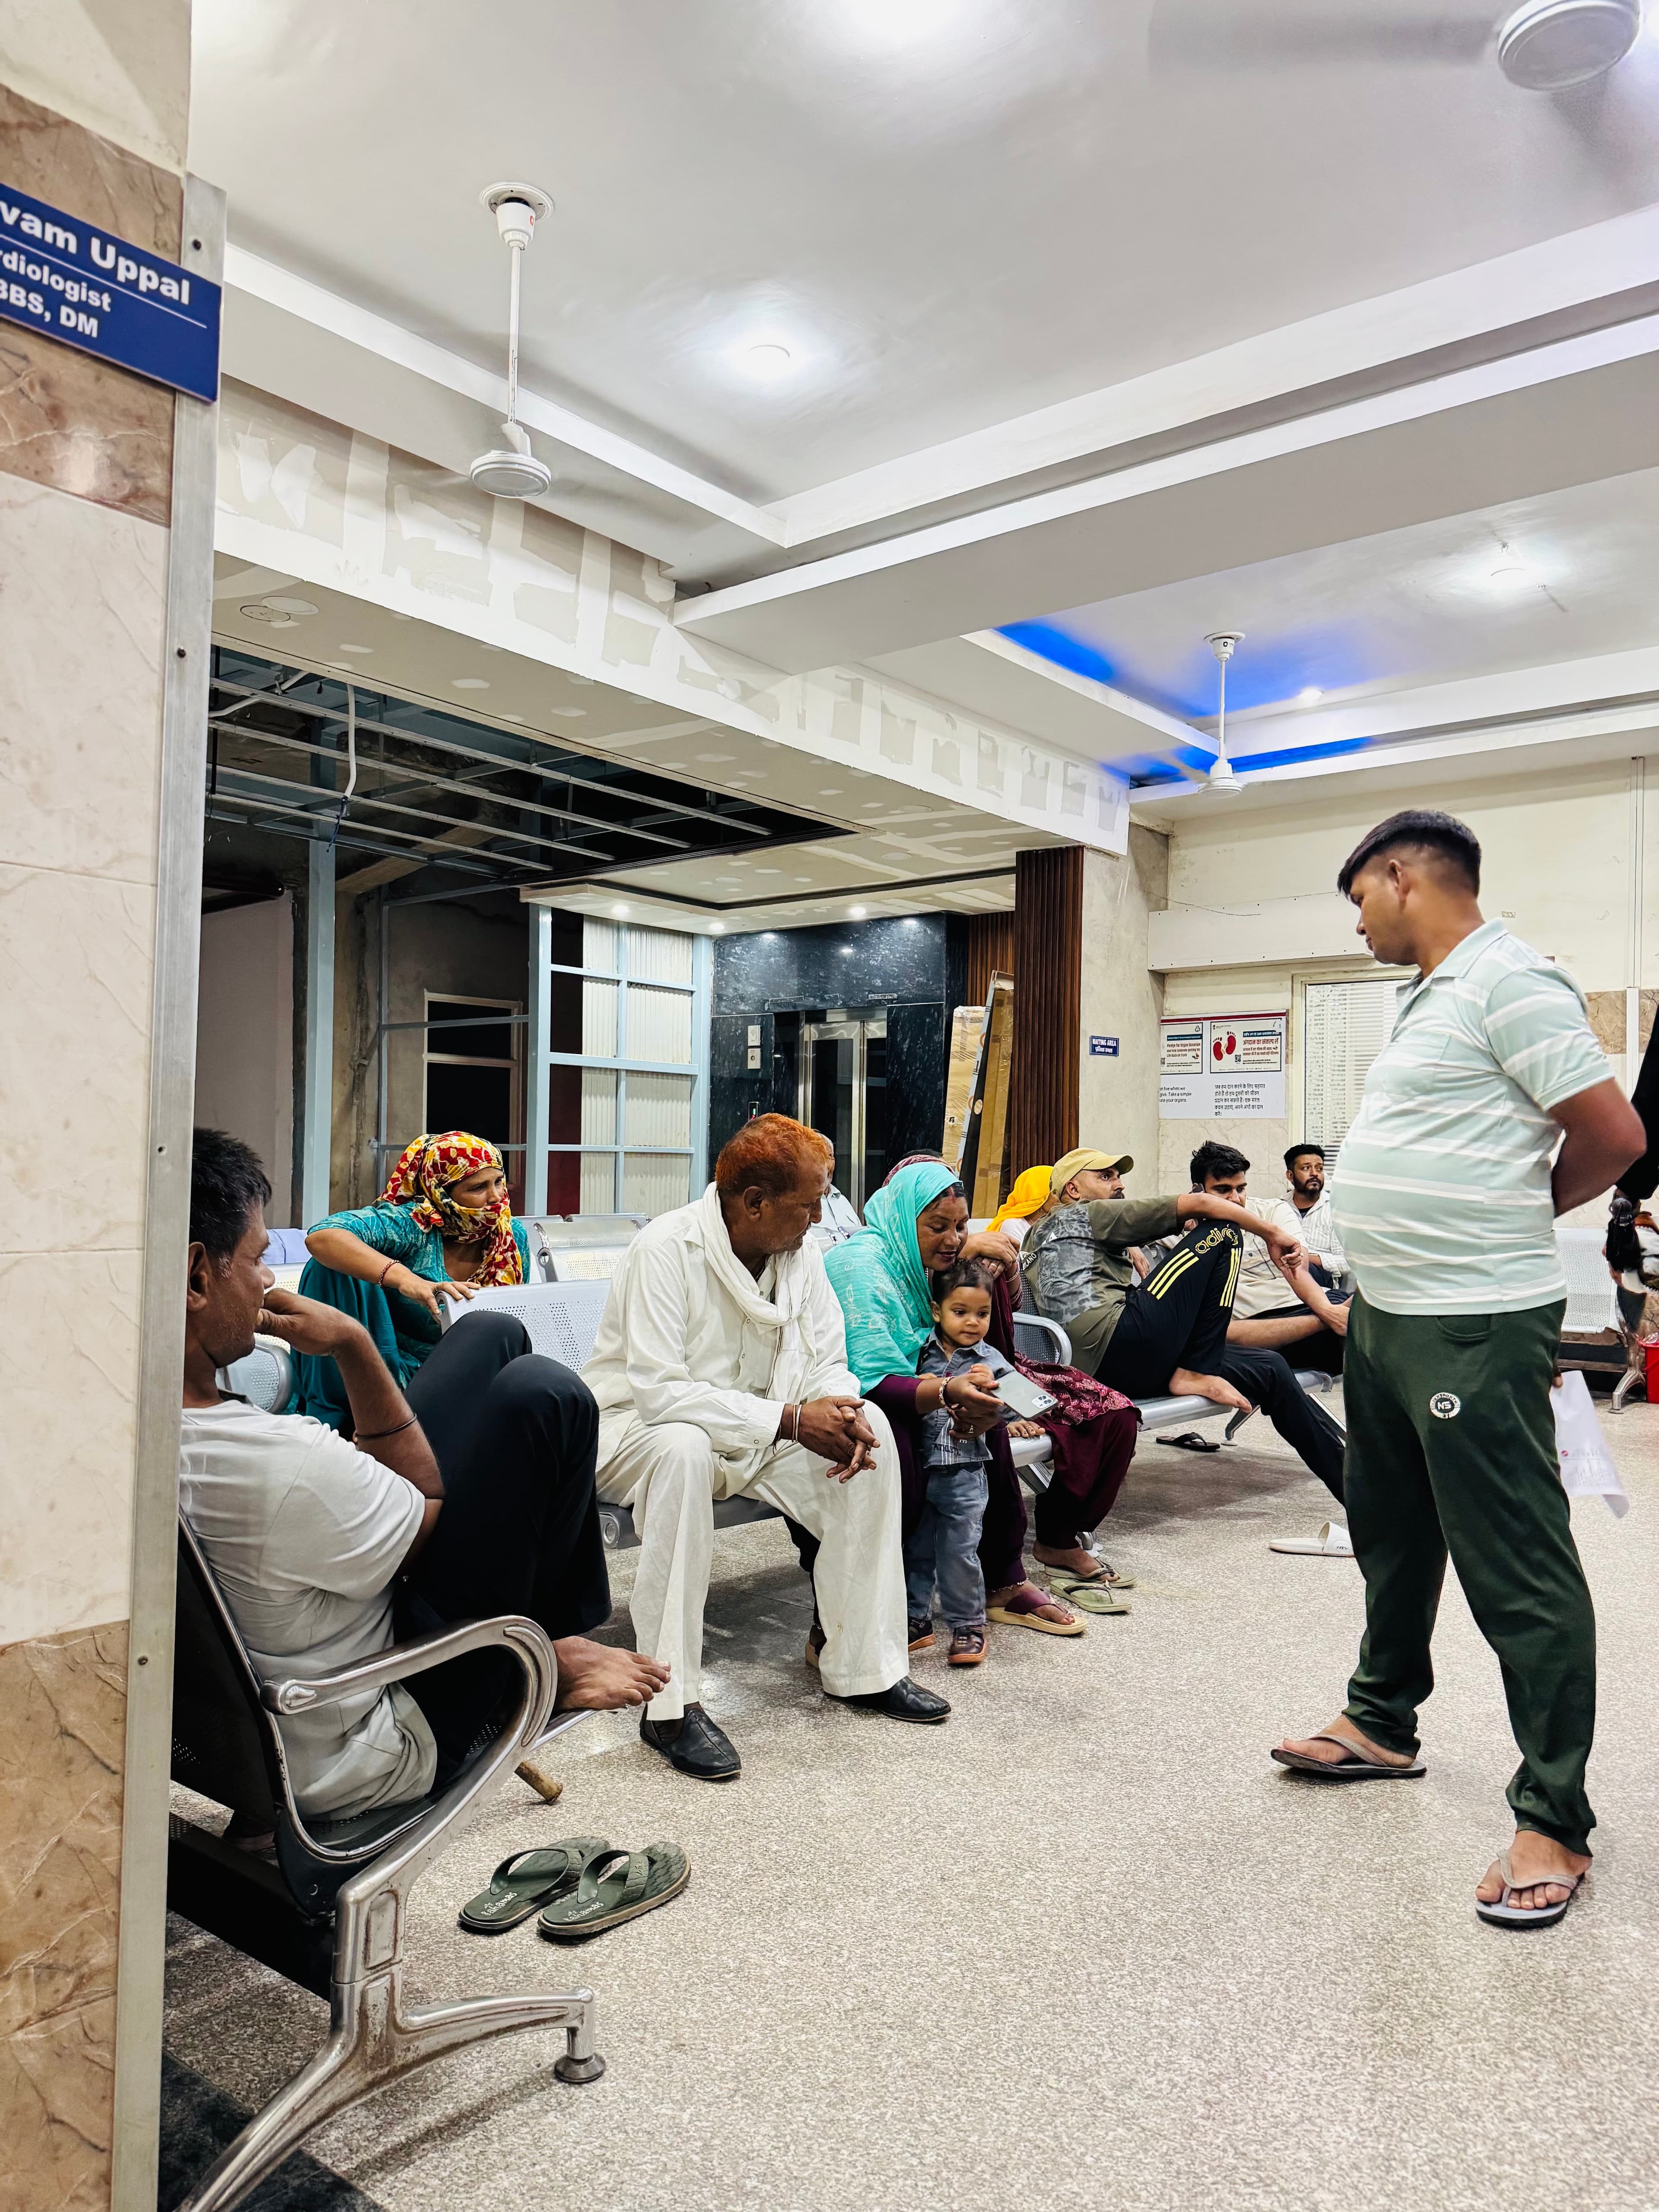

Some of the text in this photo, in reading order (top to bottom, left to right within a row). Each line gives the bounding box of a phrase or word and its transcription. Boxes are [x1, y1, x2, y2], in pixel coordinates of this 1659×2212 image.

[0, 249, 111, 312] diologist
[91, 236, 190, 305] Uppal
[59, 305, 98, 338] DM
